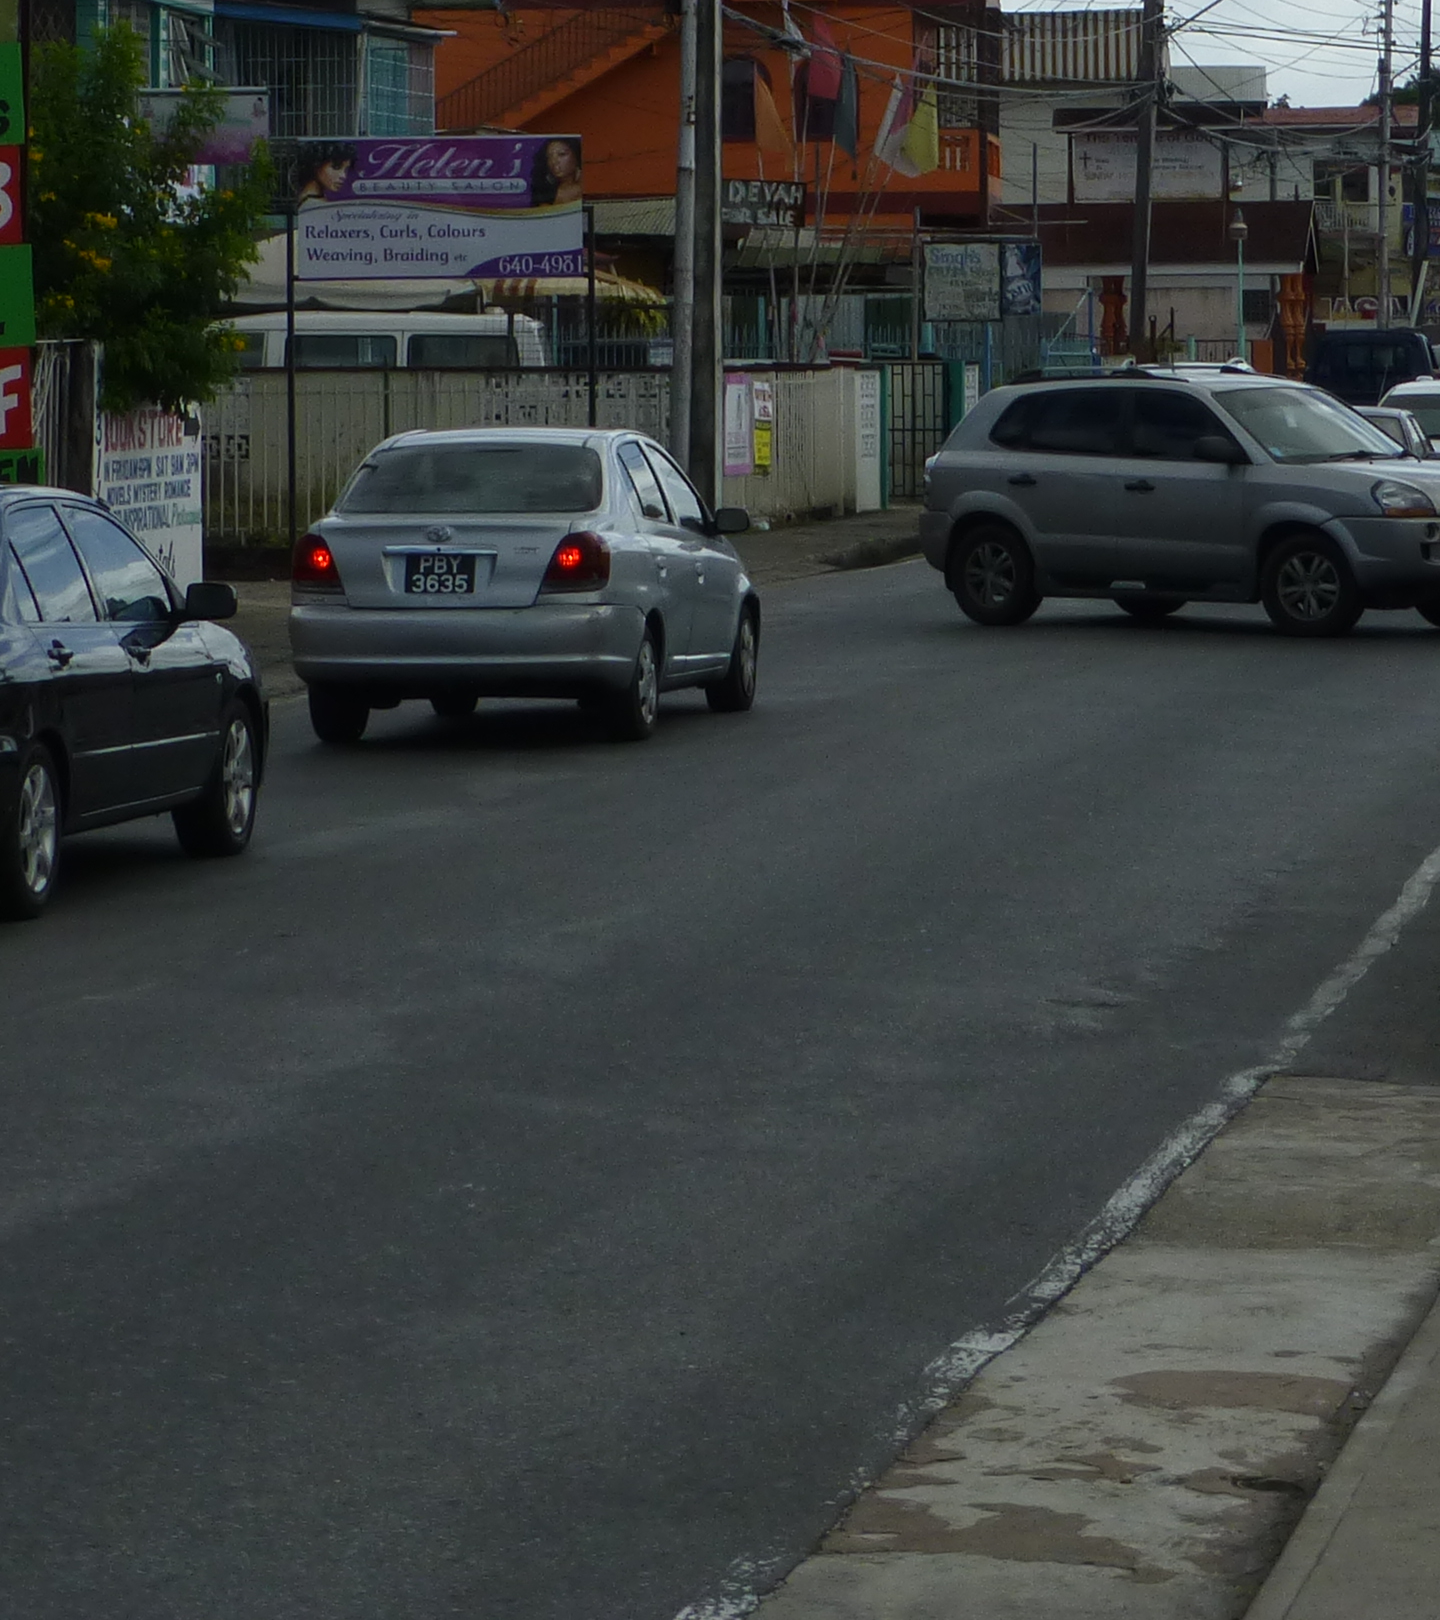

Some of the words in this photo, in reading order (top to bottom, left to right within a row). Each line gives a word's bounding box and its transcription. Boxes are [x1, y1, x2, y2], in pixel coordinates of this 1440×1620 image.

[359, 182, 439, 193] BEAUTY
[451, 182, 522, 192] SALON
[305, 225, 375, 241] Relaxers,
[380, 224, 423, 241] Curls,
[428, 223, 487, 239] Colours
[306, 247, 378, 265] Weaving,
[384, 246, 450, 265] Braiding
[420, 555, 463, 574] PBY
[412, 574, 469, 593] 3635
